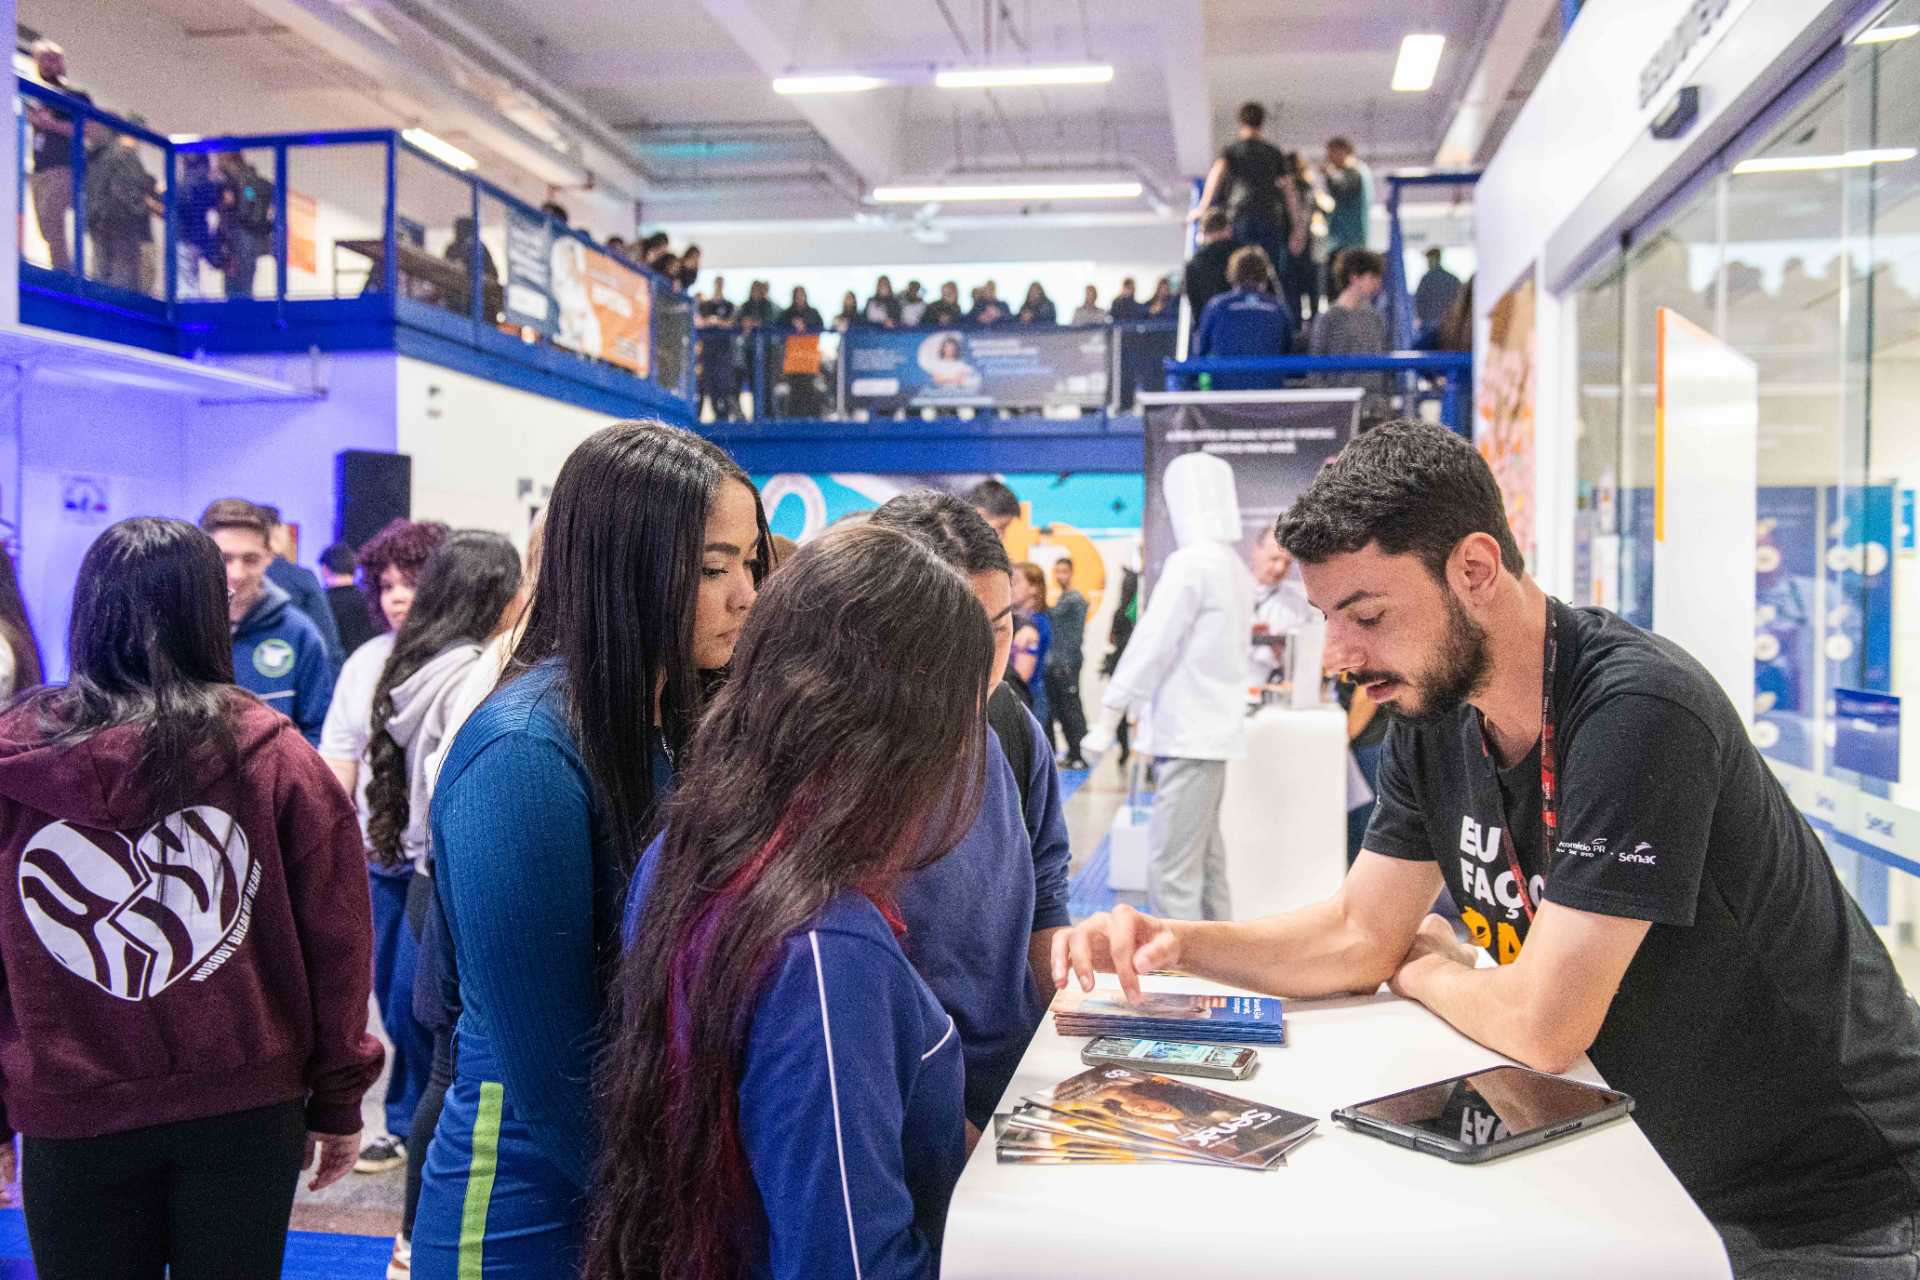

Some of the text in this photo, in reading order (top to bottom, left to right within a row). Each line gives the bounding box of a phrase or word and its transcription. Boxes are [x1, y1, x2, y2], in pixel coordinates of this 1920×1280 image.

[1460, 815, 1501, 863] EU
[1618, 852, 1656, 865] Senac
[189, 942, 236, 981] NOBODY
[227, 912, 251, 945] BREAK
[245, 858, 262, 899] HEART
[1461, 905, 1522, 965] PA
[1181, 1108, 1272, 1147] Senac
